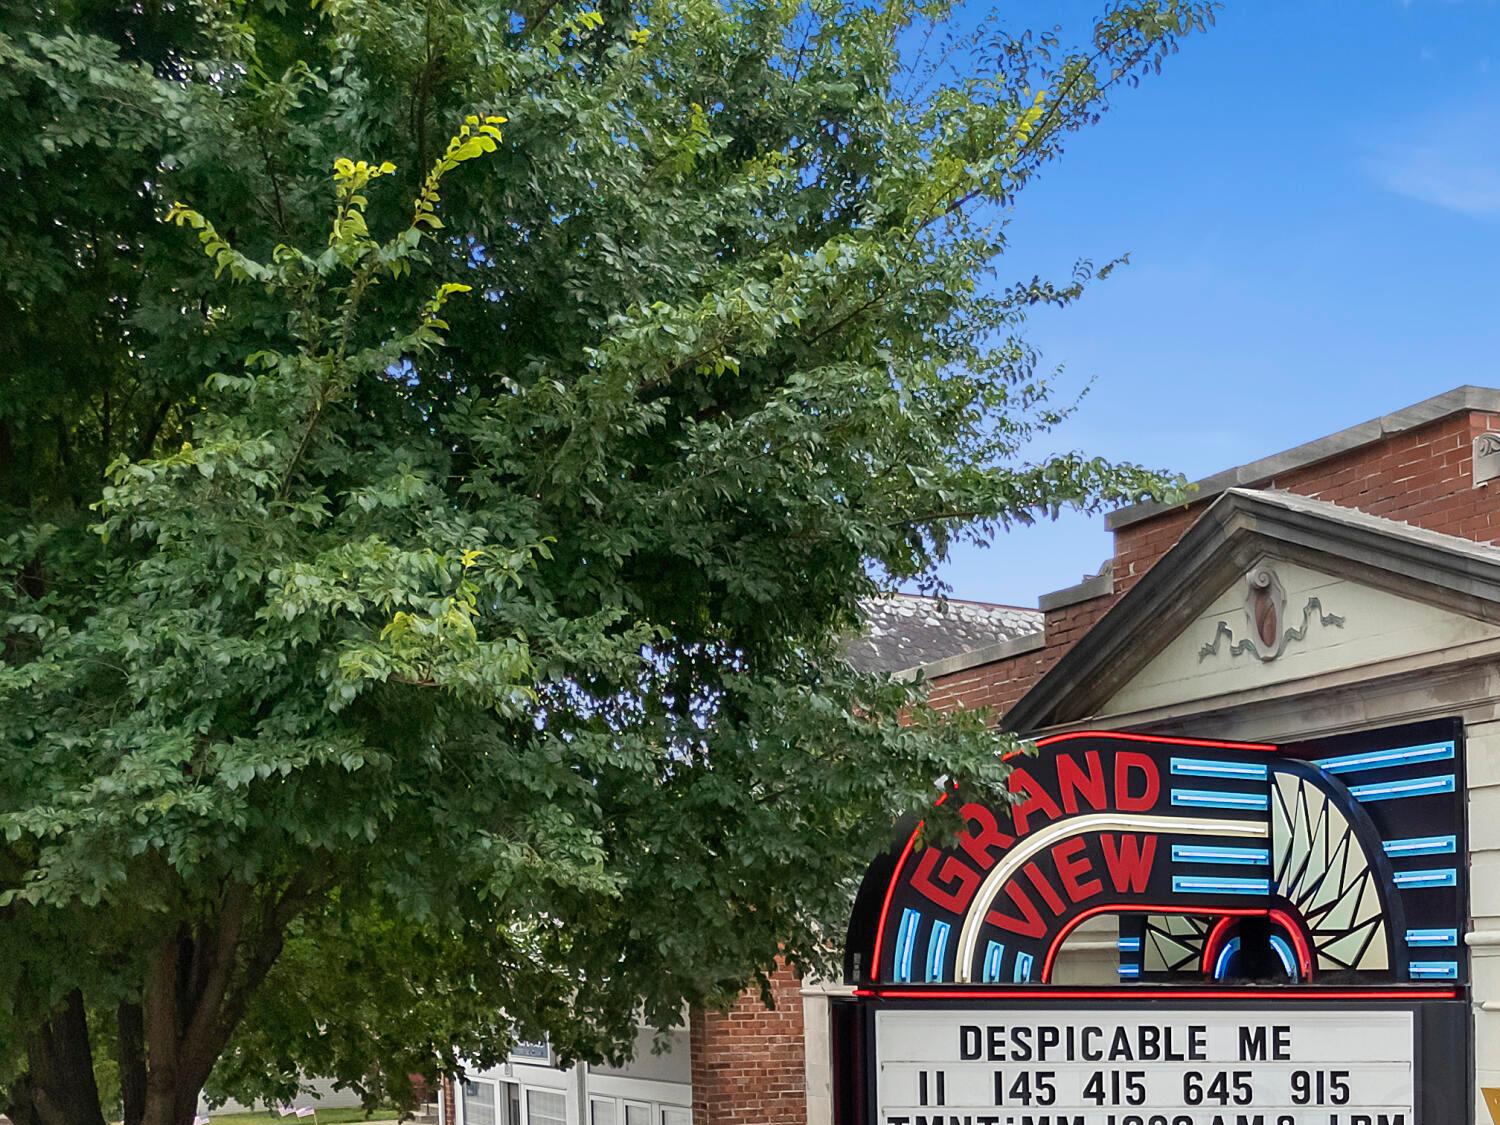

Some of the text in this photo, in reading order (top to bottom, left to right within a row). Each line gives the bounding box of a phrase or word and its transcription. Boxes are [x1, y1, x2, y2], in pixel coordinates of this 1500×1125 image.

[910, 750, 1160, 915] GRAND
[984, 834, 1158, 939] VIEW
[959, 1025, 1291, 1062] DESPICABLE ME
[919, 1070, 1350, 1106] 11 145 415 645 915
